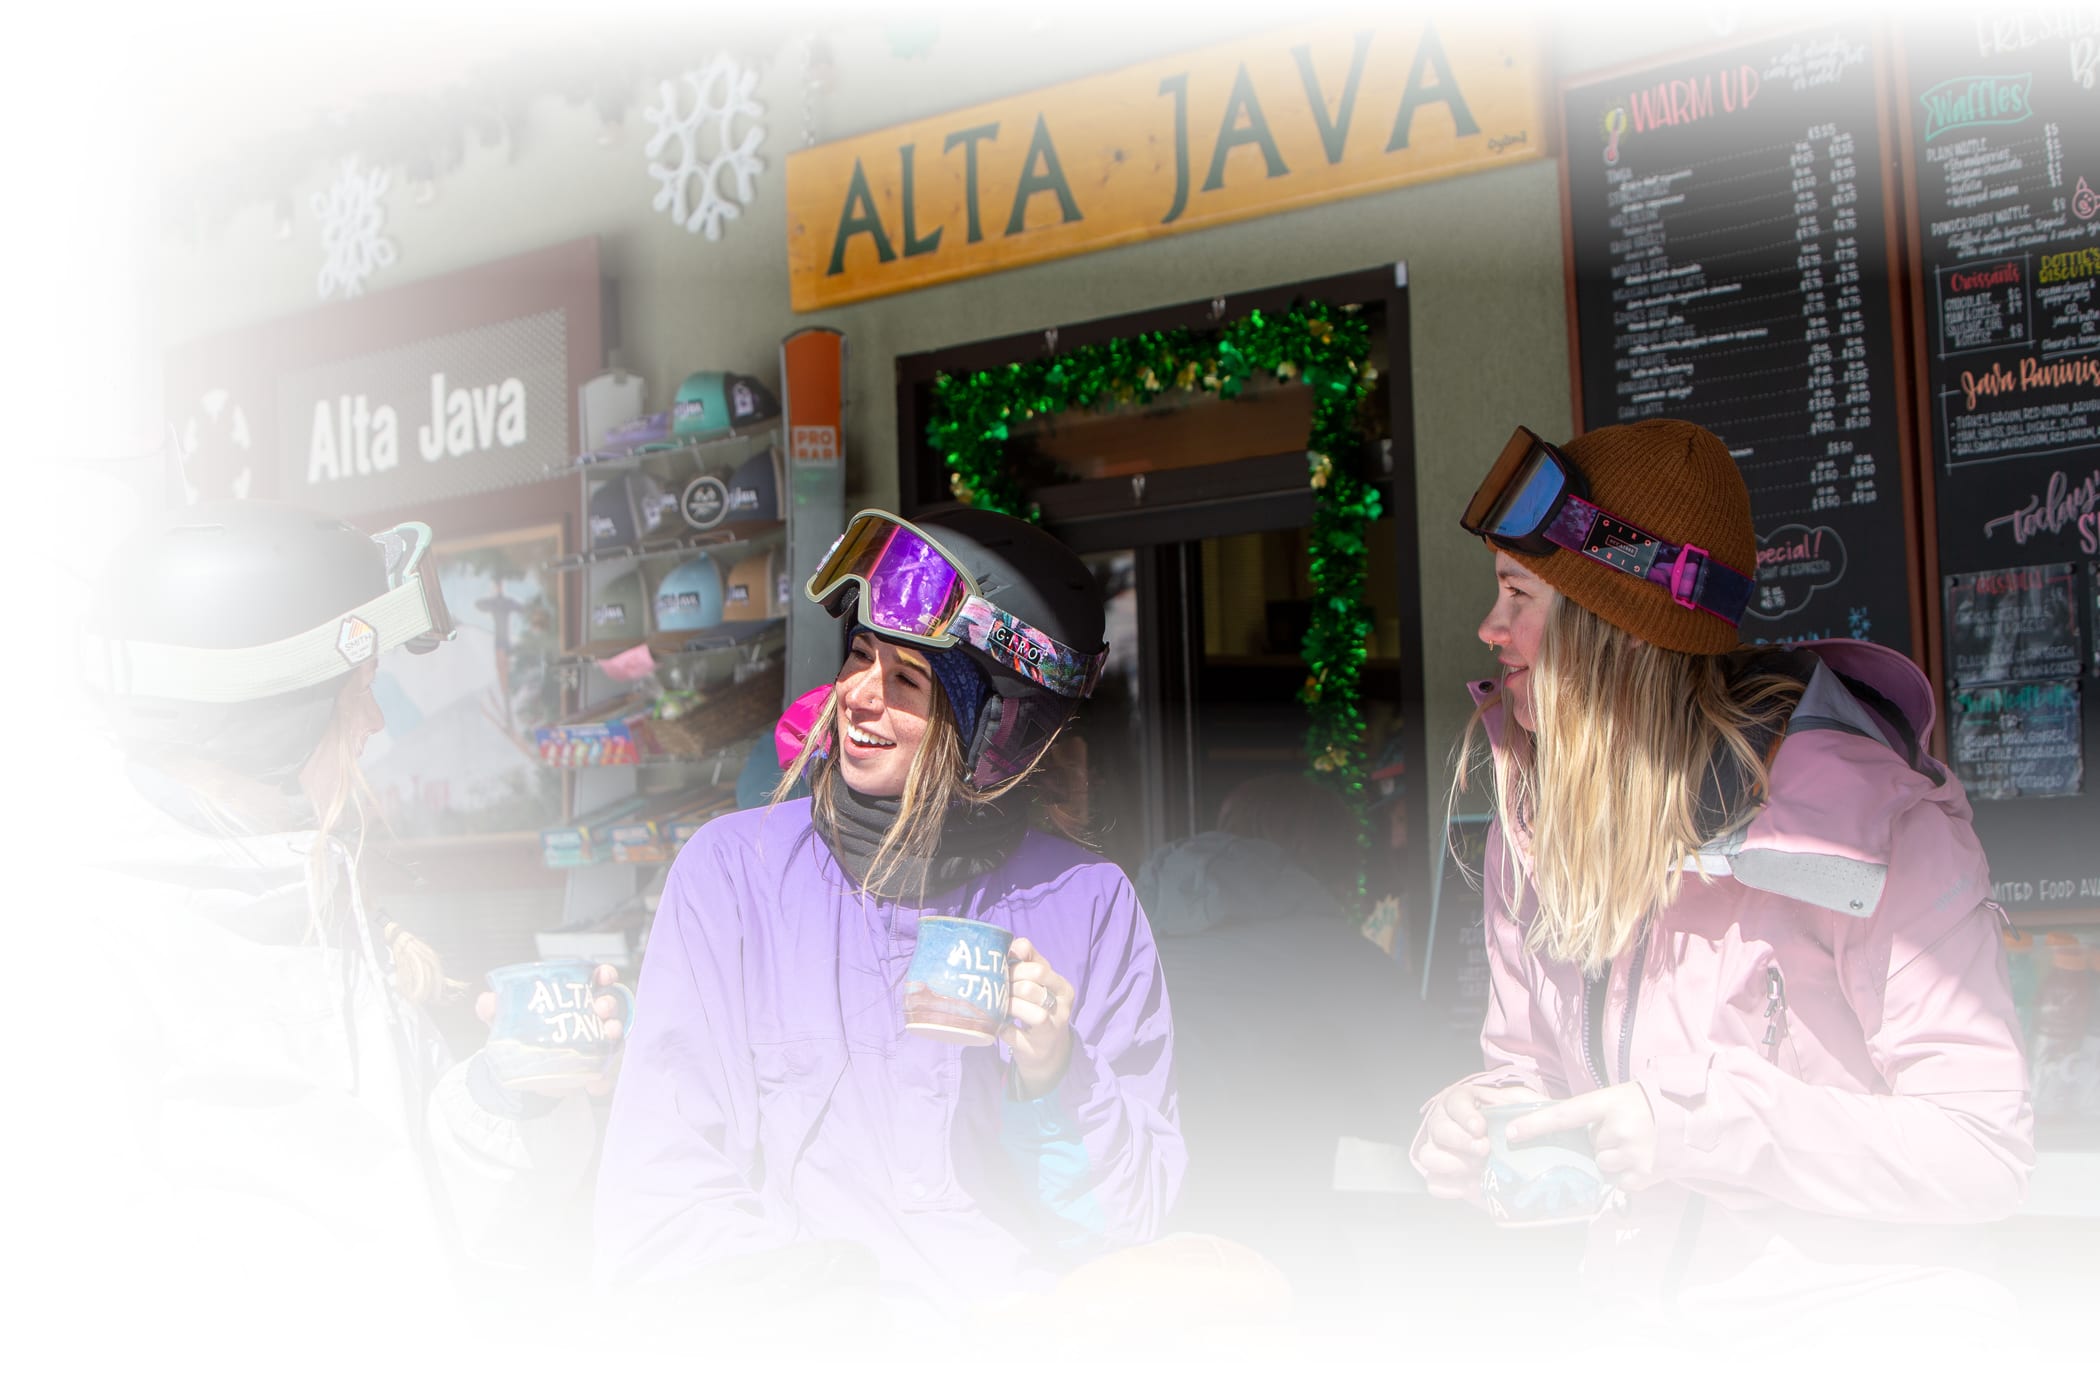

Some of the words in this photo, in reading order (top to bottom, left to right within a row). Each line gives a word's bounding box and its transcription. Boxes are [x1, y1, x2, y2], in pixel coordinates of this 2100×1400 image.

[1630, 75, 1715, 134] WARM
[1719, 64, 1761, 113] UP
[1932, 79, 2023, 128] Waffles
[825, 110, 1084, 277] ALTA
[1157, 18, 1482, 225] JAVA
[1994, 204, 2031, 223] WAFFLE
[1951, 261, 2021, 292] Croissants
[1960, 361, 2017, 411] Java
[306, 394, 399, 484] Alta
[418, 372, 527, 463] Java
[797, 430, 833, 446] PRO
[1756, 531, 1823, 568] pecial!
[2039, 879, 2076, 902] FOOD
